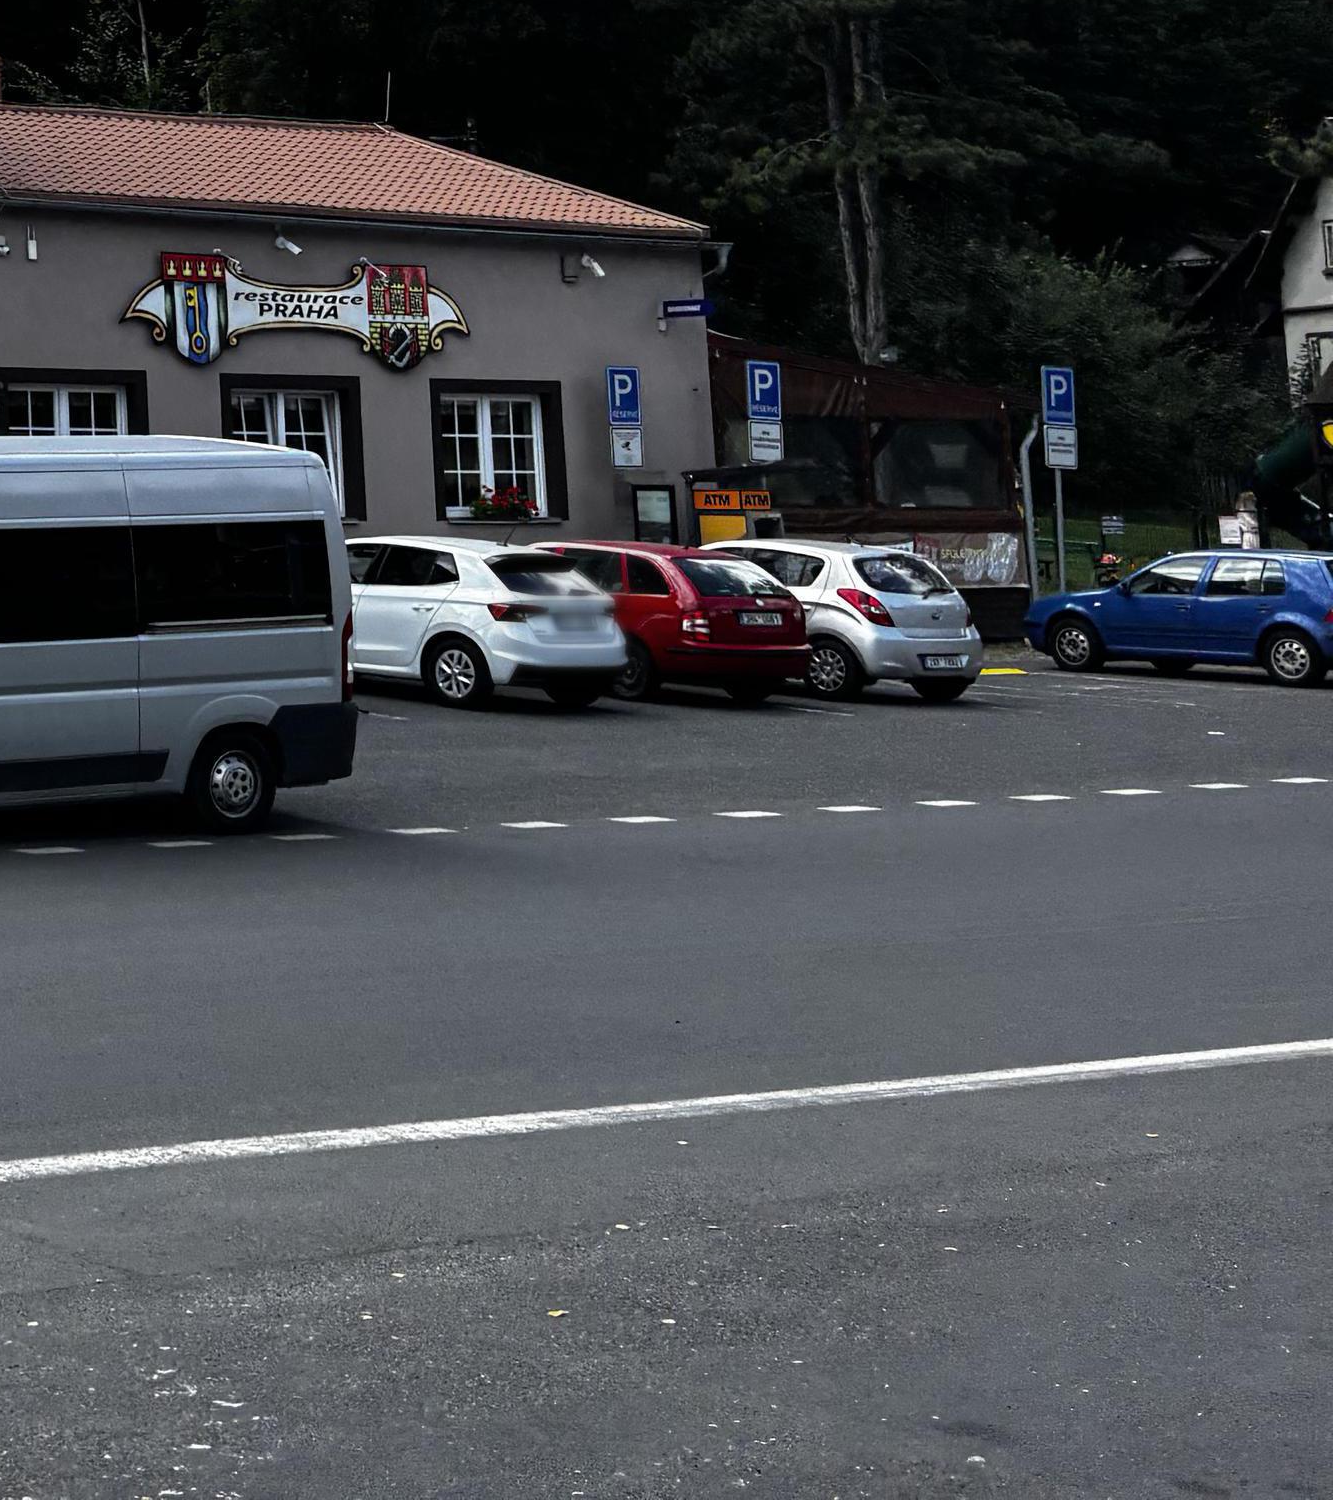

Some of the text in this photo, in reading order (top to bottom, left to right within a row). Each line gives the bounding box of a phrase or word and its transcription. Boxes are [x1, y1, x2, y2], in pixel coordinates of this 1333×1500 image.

[233, 291, 364, 305] restaurace
[258, 303, 339, 319] PRAHA
[613, 374, 633, 407] P
[754, 369, 773, 402] P
[1050, 374, 1068, 407] P
[704, 494, 731, 506] ATM
[744, 494, 770, 506] ATM
